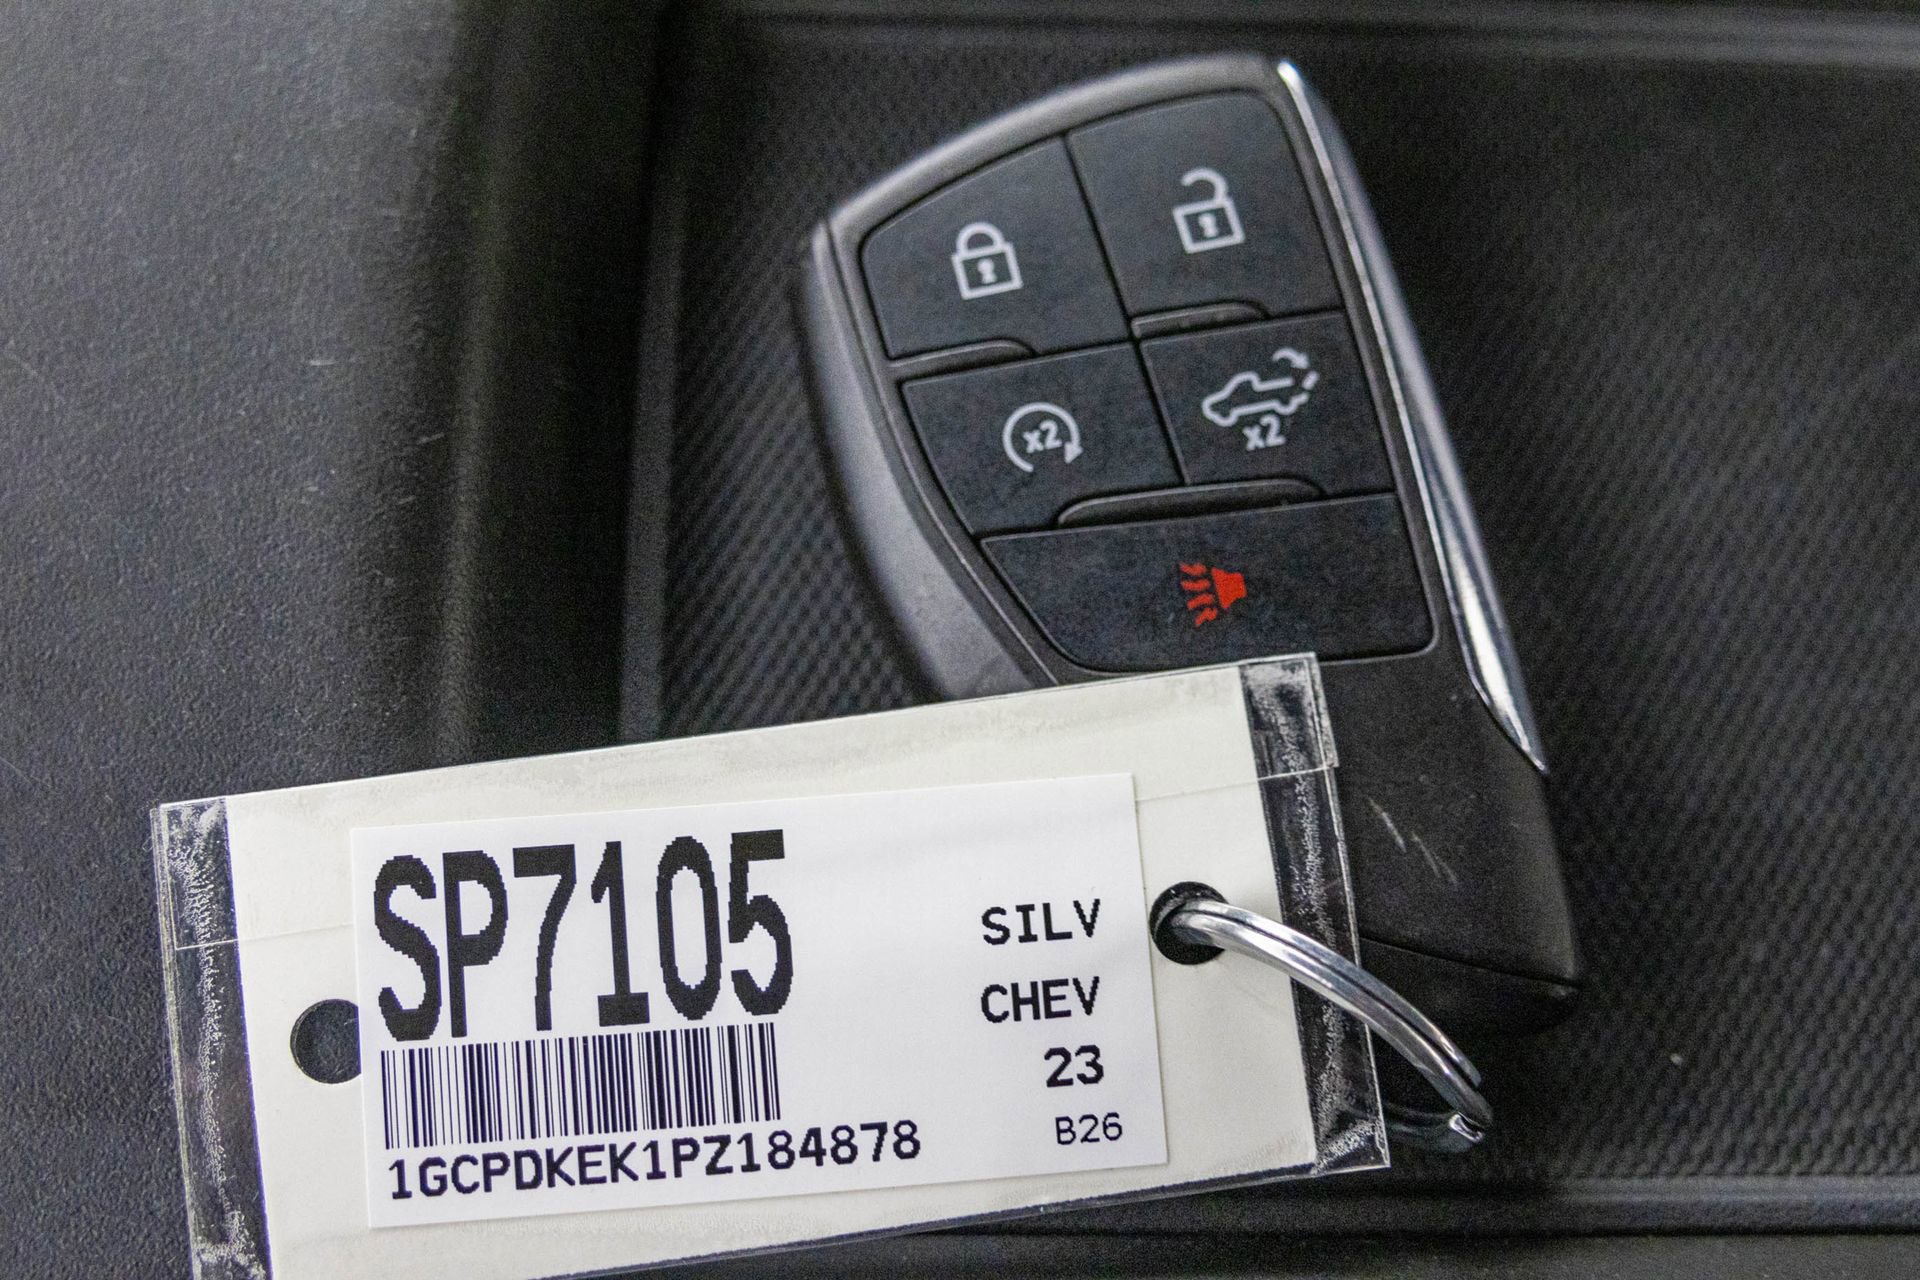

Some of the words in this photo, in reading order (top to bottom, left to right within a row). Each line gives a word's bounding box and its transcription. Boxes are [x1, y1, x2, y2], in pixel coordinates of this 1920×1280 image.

[373, 829, 794, 1042] SP7105
[981, 898, 1102, 946] SILV
[980, 975, 1101, 1024] CHEV
[1043, 1044, 1105, 1088] 23
[1055, 1112, 1123, 1146] B26
[388, 1119, 921, 1200] 1GCPDKEK1PZ184878
